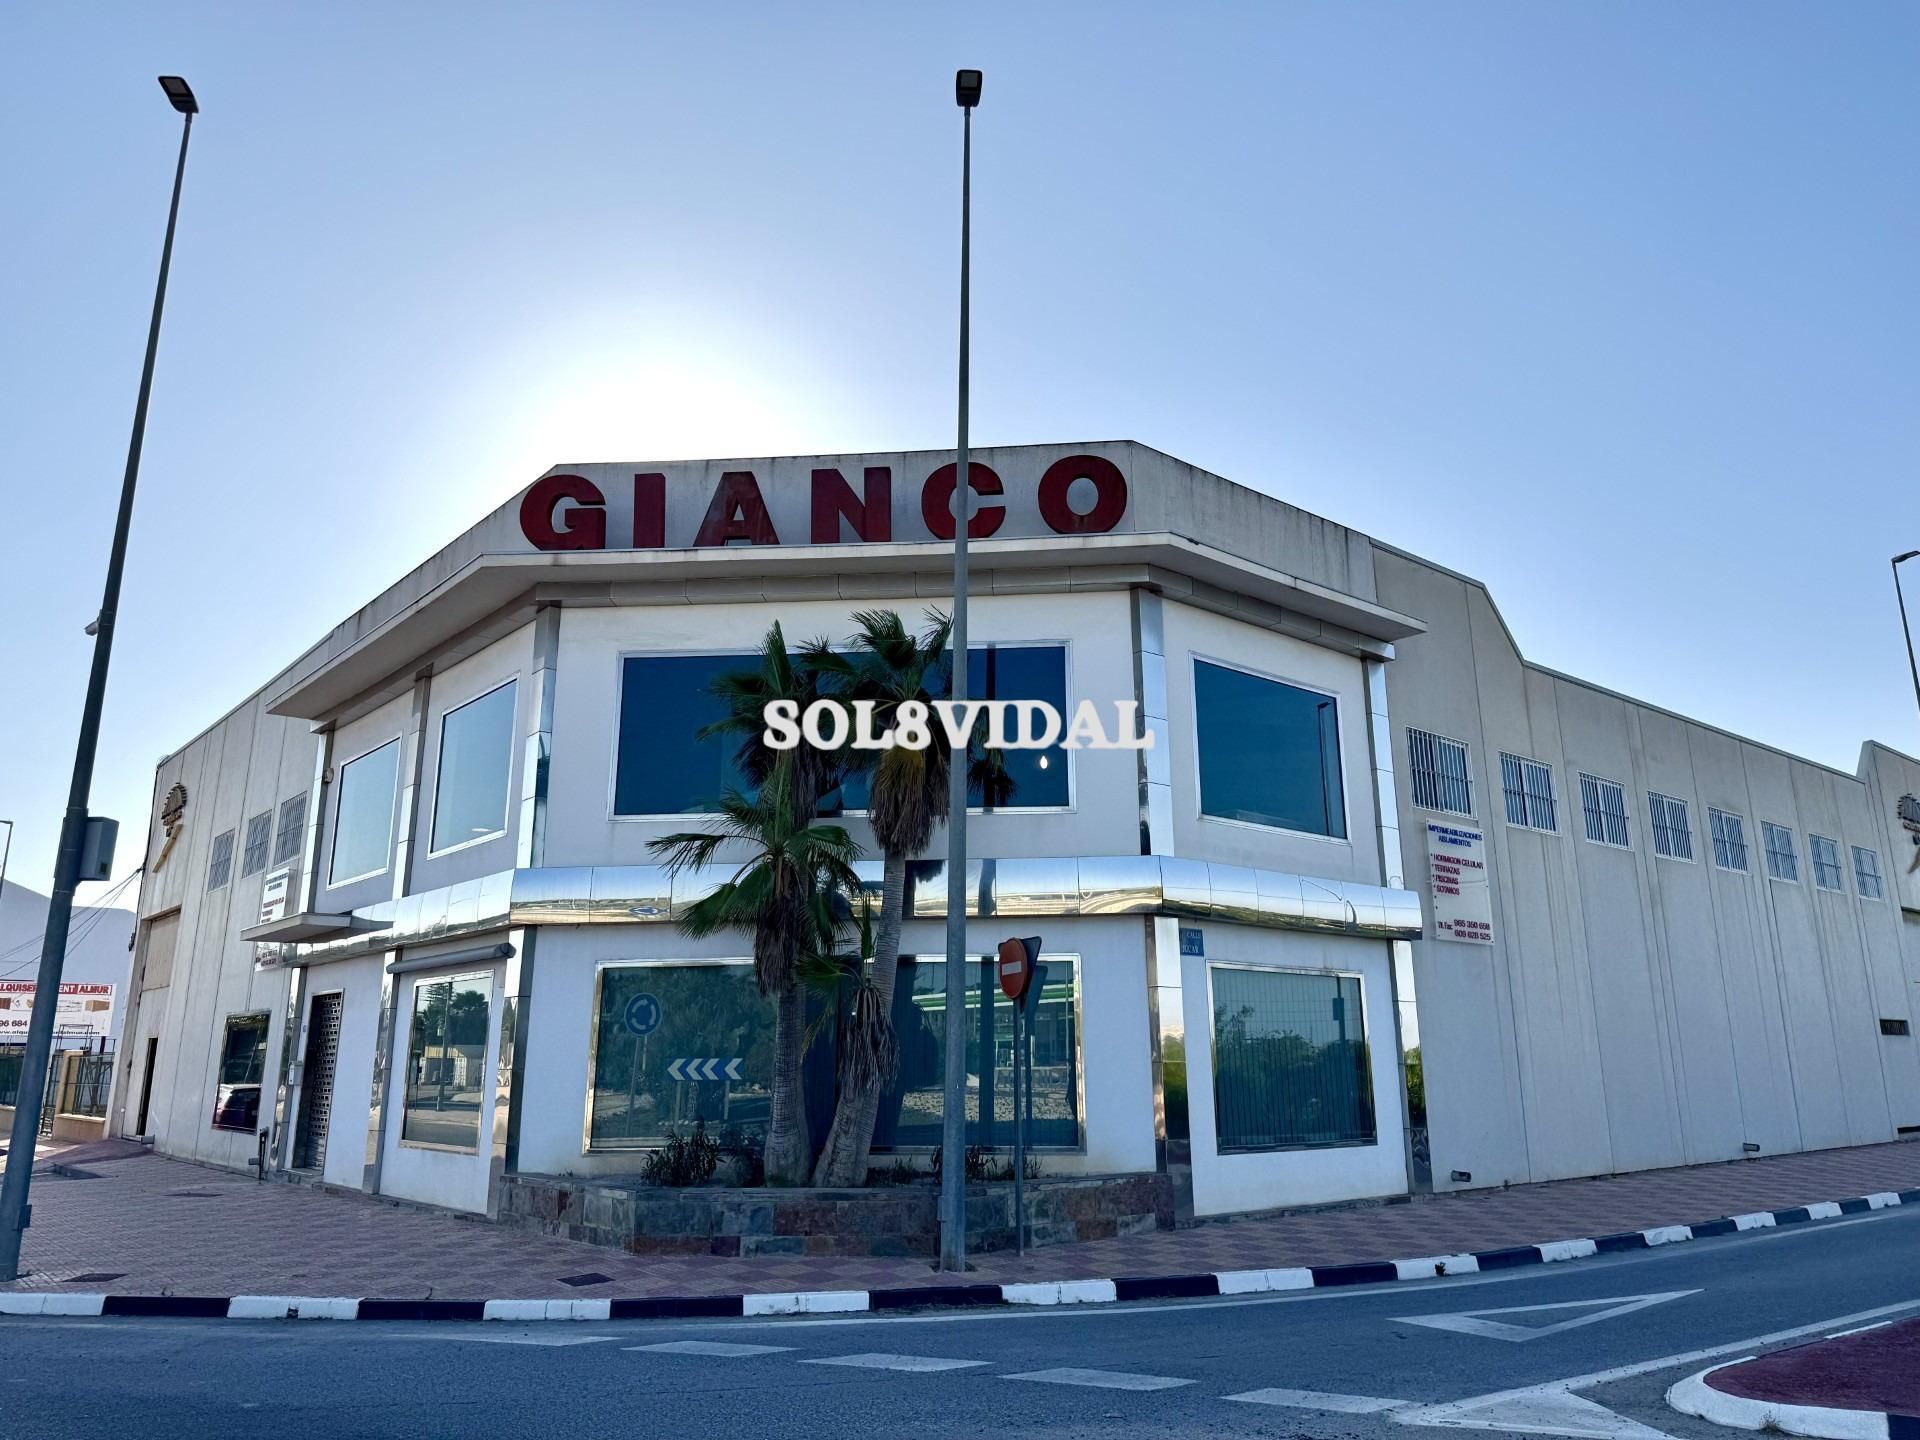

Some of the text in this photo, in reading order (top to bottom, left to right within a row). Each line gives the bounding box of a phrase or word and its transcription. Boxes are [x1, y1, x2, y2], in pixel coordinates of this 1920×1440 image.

[519, 454, 1128, 551] GIANCO
[1438, 835, 1472, 848] AISLAMIENTOS
[1434, 864, 1460, 875] TERRAZAS
[1462, 858, 1484, 870] CELULAR
[1435, 874, 1459, 885] PISCINAS
[0, 983, 36, 992] LQUISE
[58, 984, 76, 993] ENT
